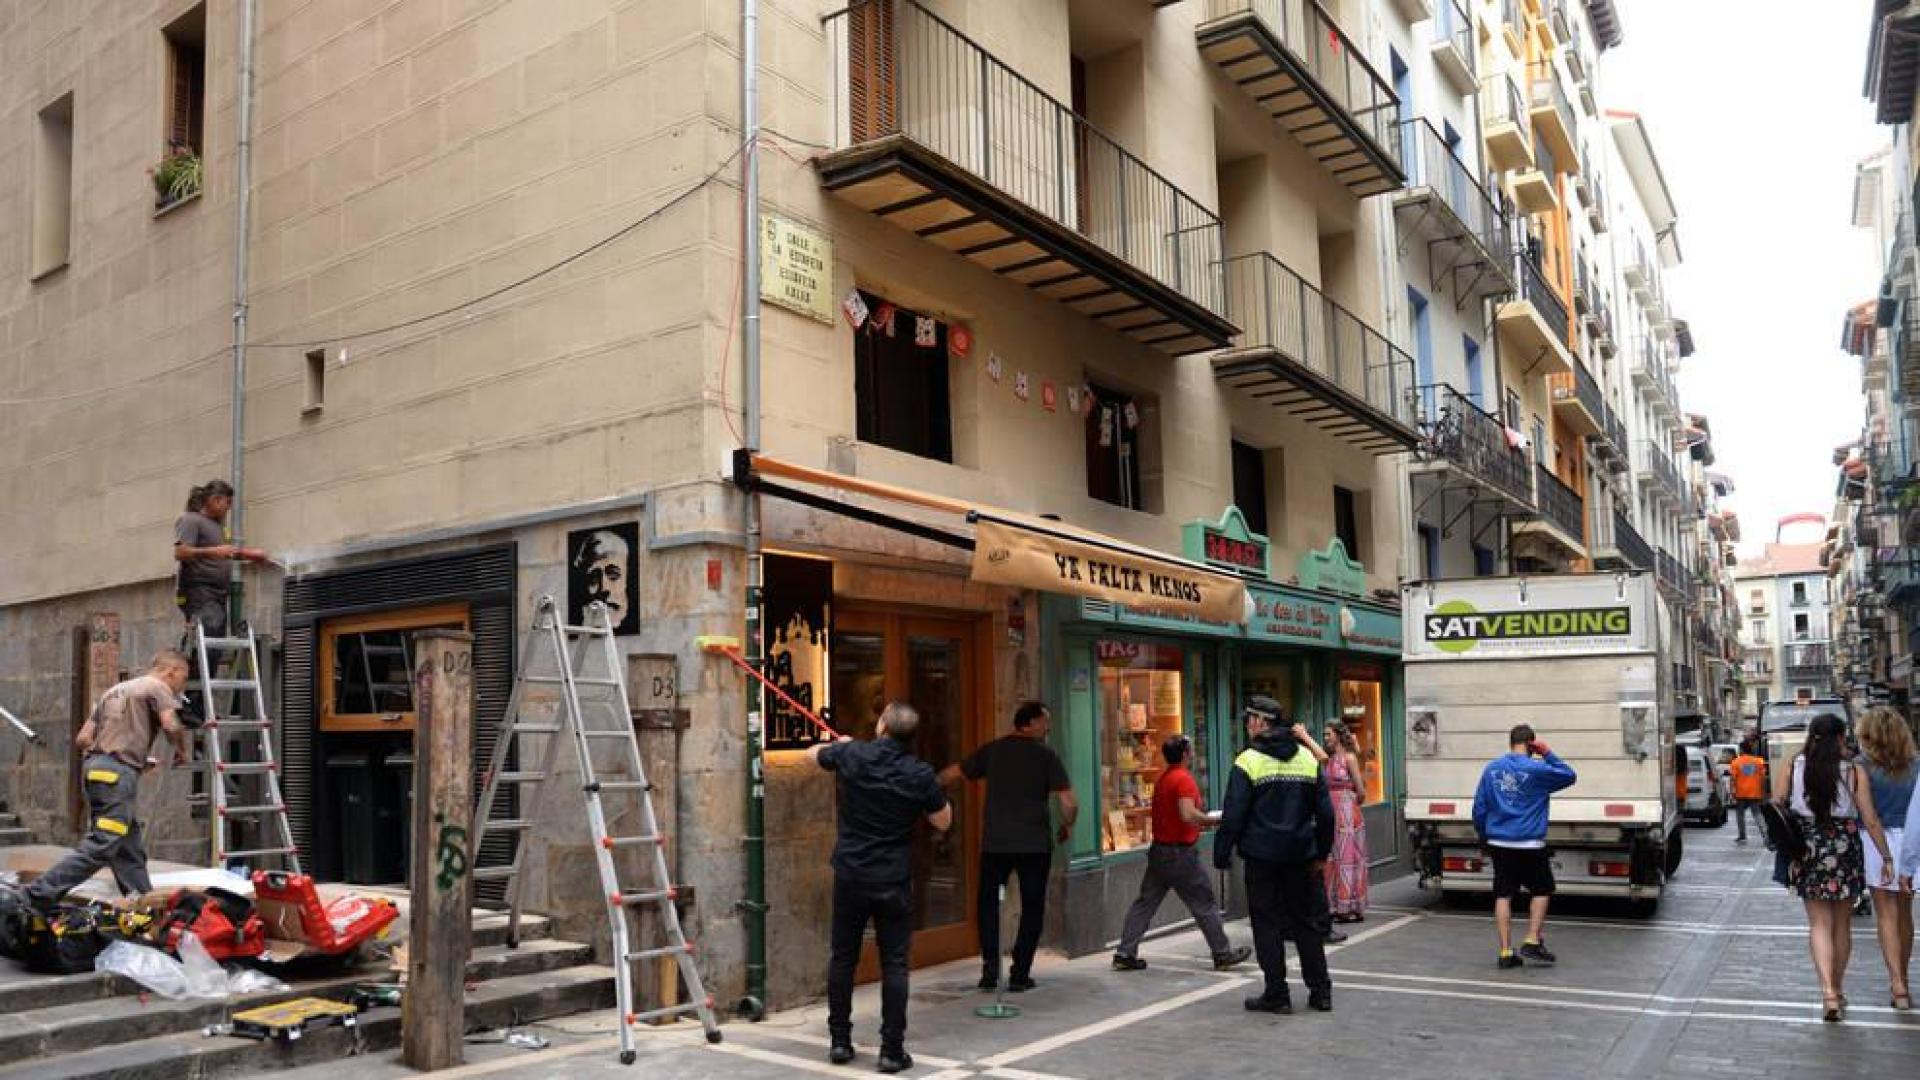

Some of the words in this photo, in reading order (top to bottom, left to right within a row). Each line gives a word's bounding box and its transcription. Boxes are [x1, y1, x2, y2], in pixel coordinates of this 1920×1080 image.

[787, 232, 808, 251] CALLE
[1055, 552, 1082, 580] YA
[1087, 559, 1144, 592] FALTA
[1149, 573, 1201, 603] MENOS
[1428, 610, 1627, 638] SATVENDING
